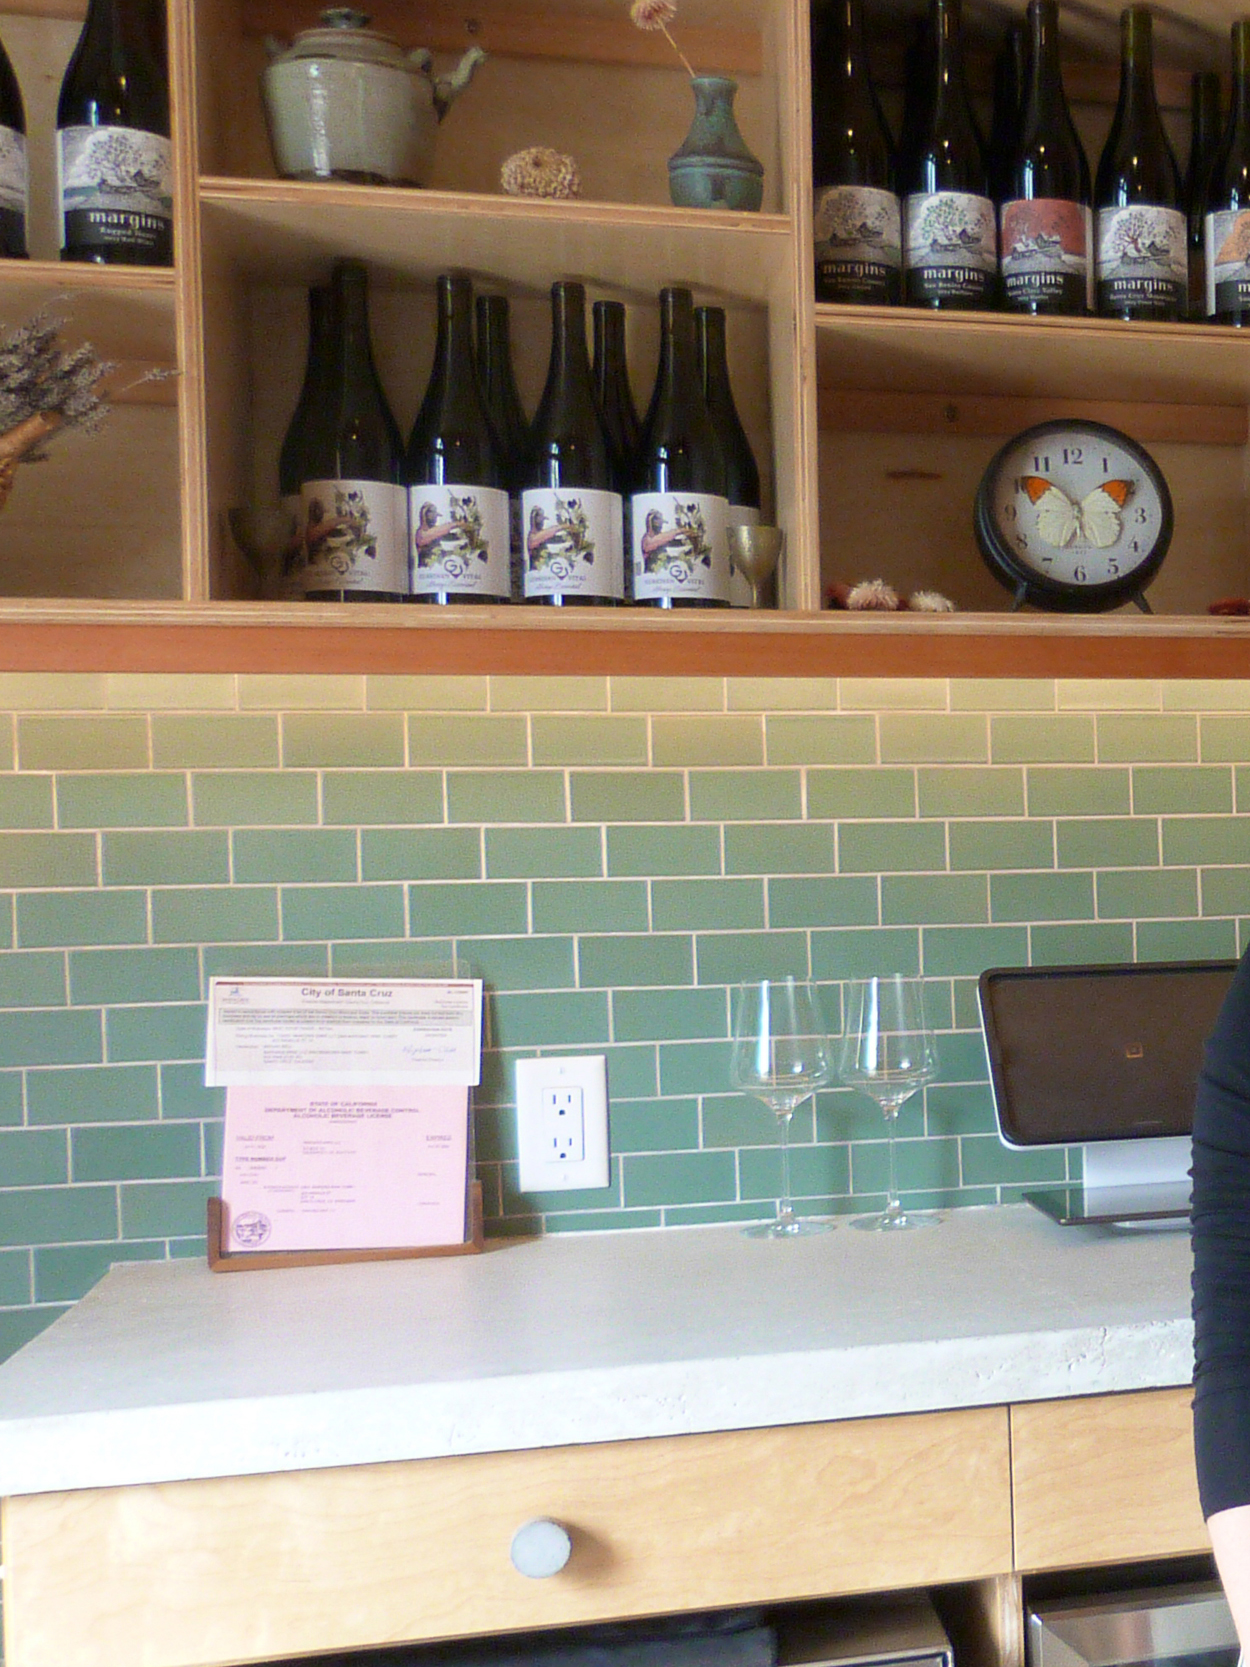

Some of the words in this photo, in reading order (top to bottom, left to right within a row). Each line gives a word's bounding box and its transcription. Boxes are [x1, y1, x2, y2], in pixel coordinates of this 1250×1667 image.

[90, 212, 164, 230] margins
[823, 263, 886, 277] margins
[924, 268, 984, 282] margins
[1007, 272, 1063, 287] margins
[1114, 279, 1173, 293] margins
[1034, 456, 1050, 472] 11
[1062, 448, 1083, 464] 12
[1102, 457, 1108, 473] 1
[1004, 504, 1017, 521] 9
[1135, 507, 1147, 524] 3
[1016, 533, 1028, 550] 8
[1128, 536, 1138, 552] 4
[1074, 565, 1086, 582] 6
[1108, 558, 1119, 575] 5
[301, 988, 321, 998] City
[324, 988, 335, 996] of
[338, 988, 366, 997] Santa
[369, 989, 393, 997] Cruz
